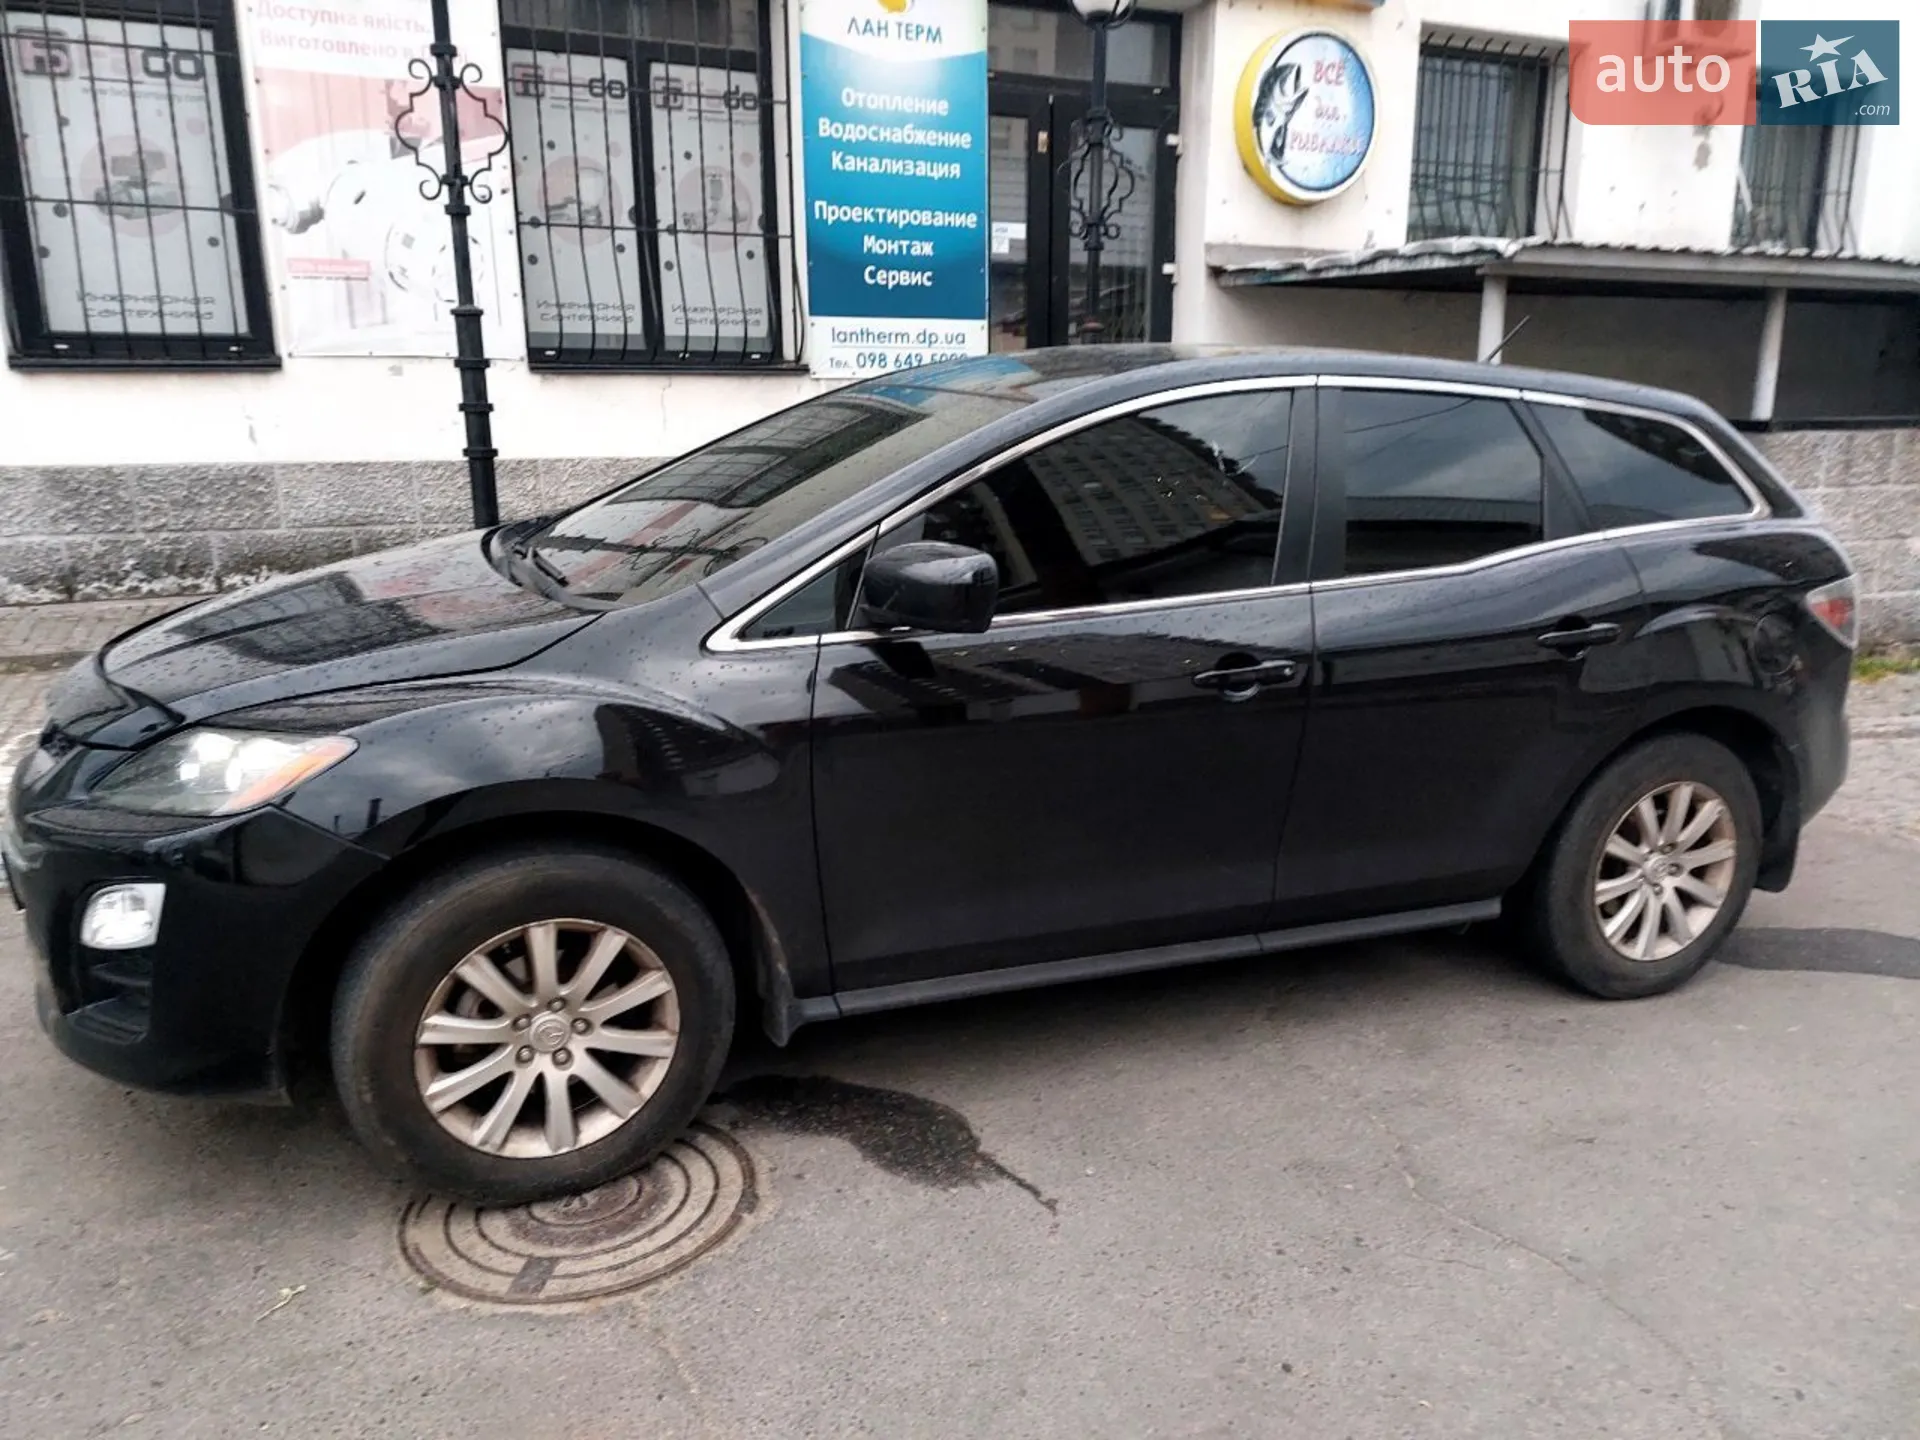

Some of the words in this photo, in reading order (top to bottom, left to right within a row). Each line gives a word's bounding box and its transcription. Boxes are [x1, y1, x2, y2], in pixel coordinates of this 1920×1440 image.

[847, 16, 889, 39] ЛАН
[896, 21, 943, 44] ТЕРМ
[841, 87, 949, 116] Отопление
[818, 117, 972, 149] Водоснабжение
[831, 151, 961, 180] Канализация
[814, 200, 977, 229] Проектирование
[863, 234, 934, 257] Монтаж
[863, 265, 933, 290] Сервис
[831, 326, 966, 347] lantherm.dp.ua
[856, 352, 887, 369] 098
[893, 353, 924, 368] 649
